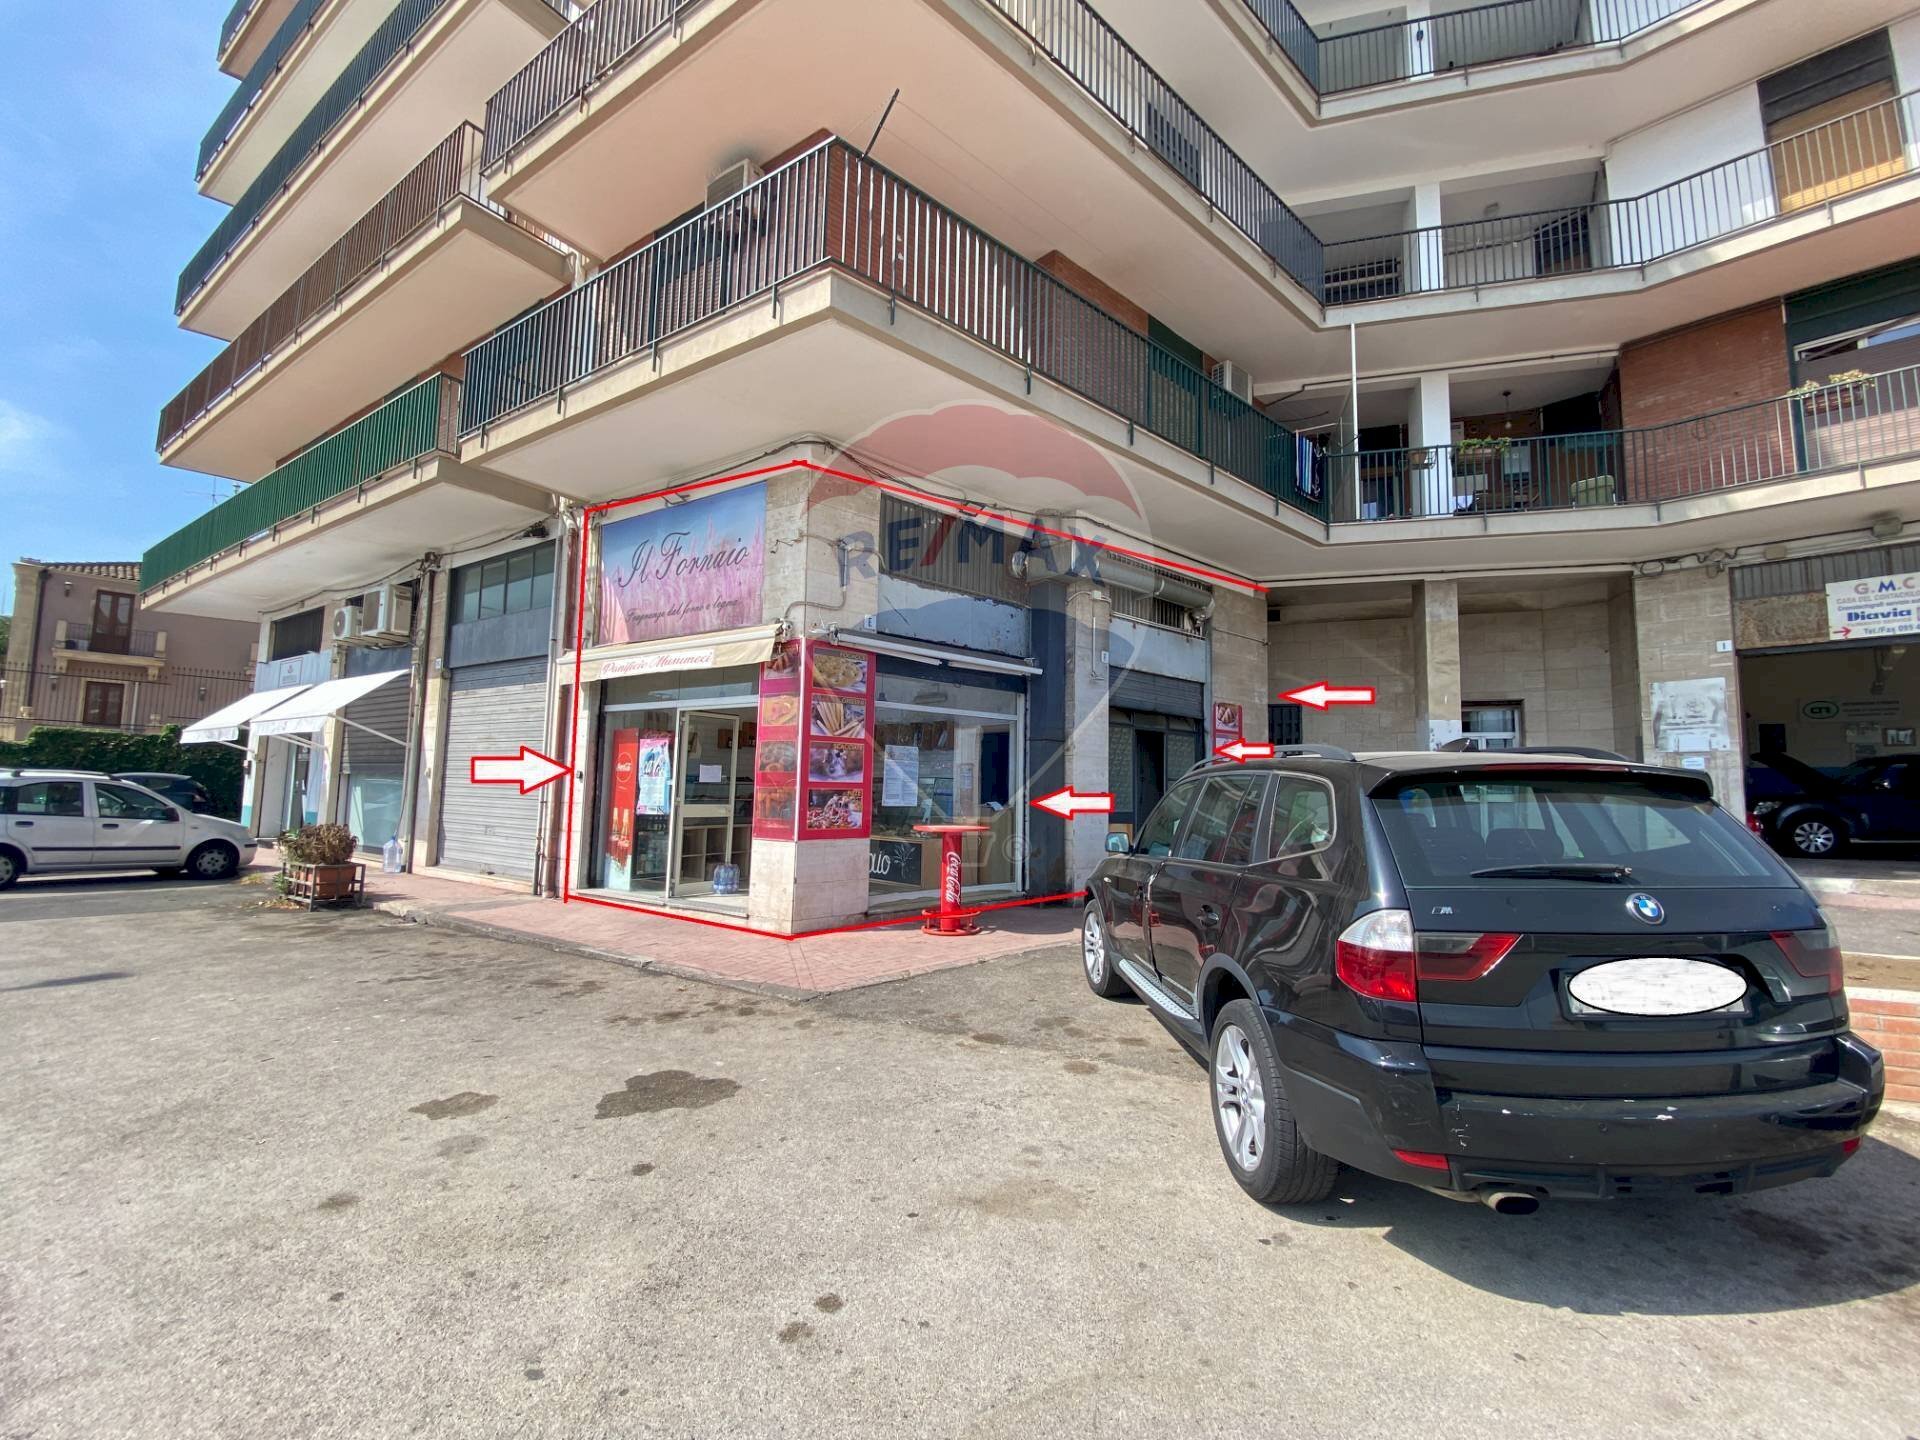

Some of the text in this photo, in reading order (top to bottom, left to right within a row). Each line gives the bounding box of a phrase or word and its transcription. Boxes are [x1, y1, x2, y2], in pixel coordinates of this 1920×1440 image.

[618, 531, 750, 588] Il Fornaio
[1847, 608, 1912, 622] Diavia
